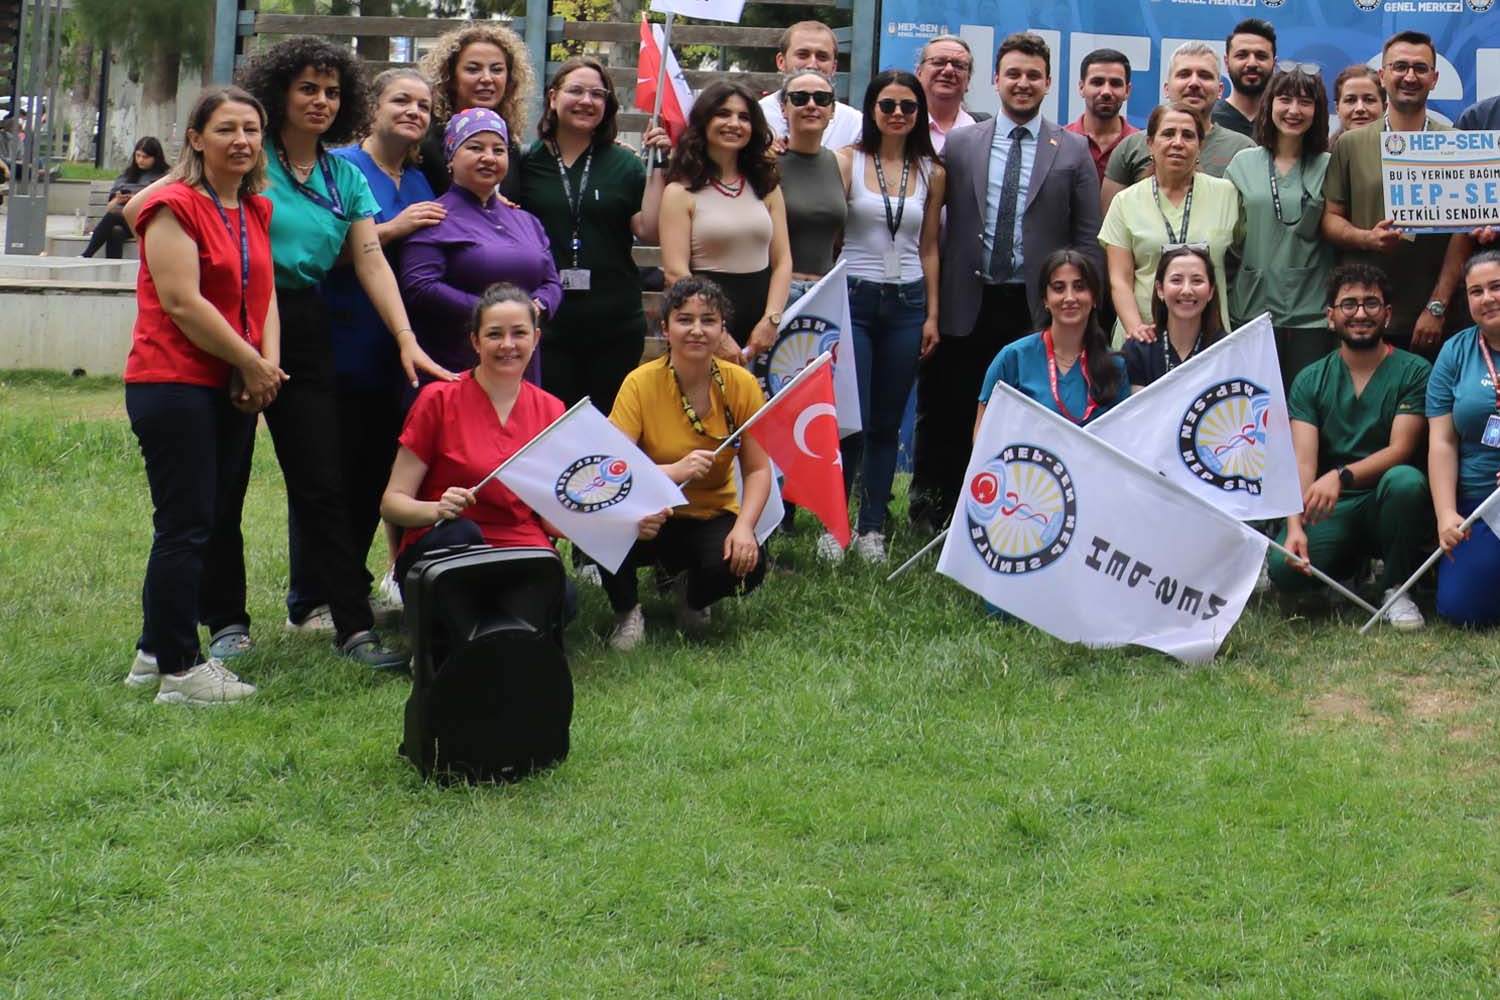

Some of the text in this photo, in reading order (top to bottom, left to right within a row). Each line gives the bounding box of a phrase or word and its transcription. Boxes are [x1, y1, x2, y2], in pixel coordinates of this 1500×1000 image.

[1384, 0, 1463, 12] GENEL MERKEZİ
[897, 23, 938, 33] HEP-SEN
[1409, 133, 1494, 151] HEP-SEN
[1389, 171, 1403, 181] BU
[1407, 168, 1417, 181] İŞ
[1421, 168, 1465, 180] YERİNDE
[1392, 206, 1440, 221] YETKİLİ
[1181, 381, 1254, 439] HEP-SEN
[1183, 450, 1214, 481] HEP
